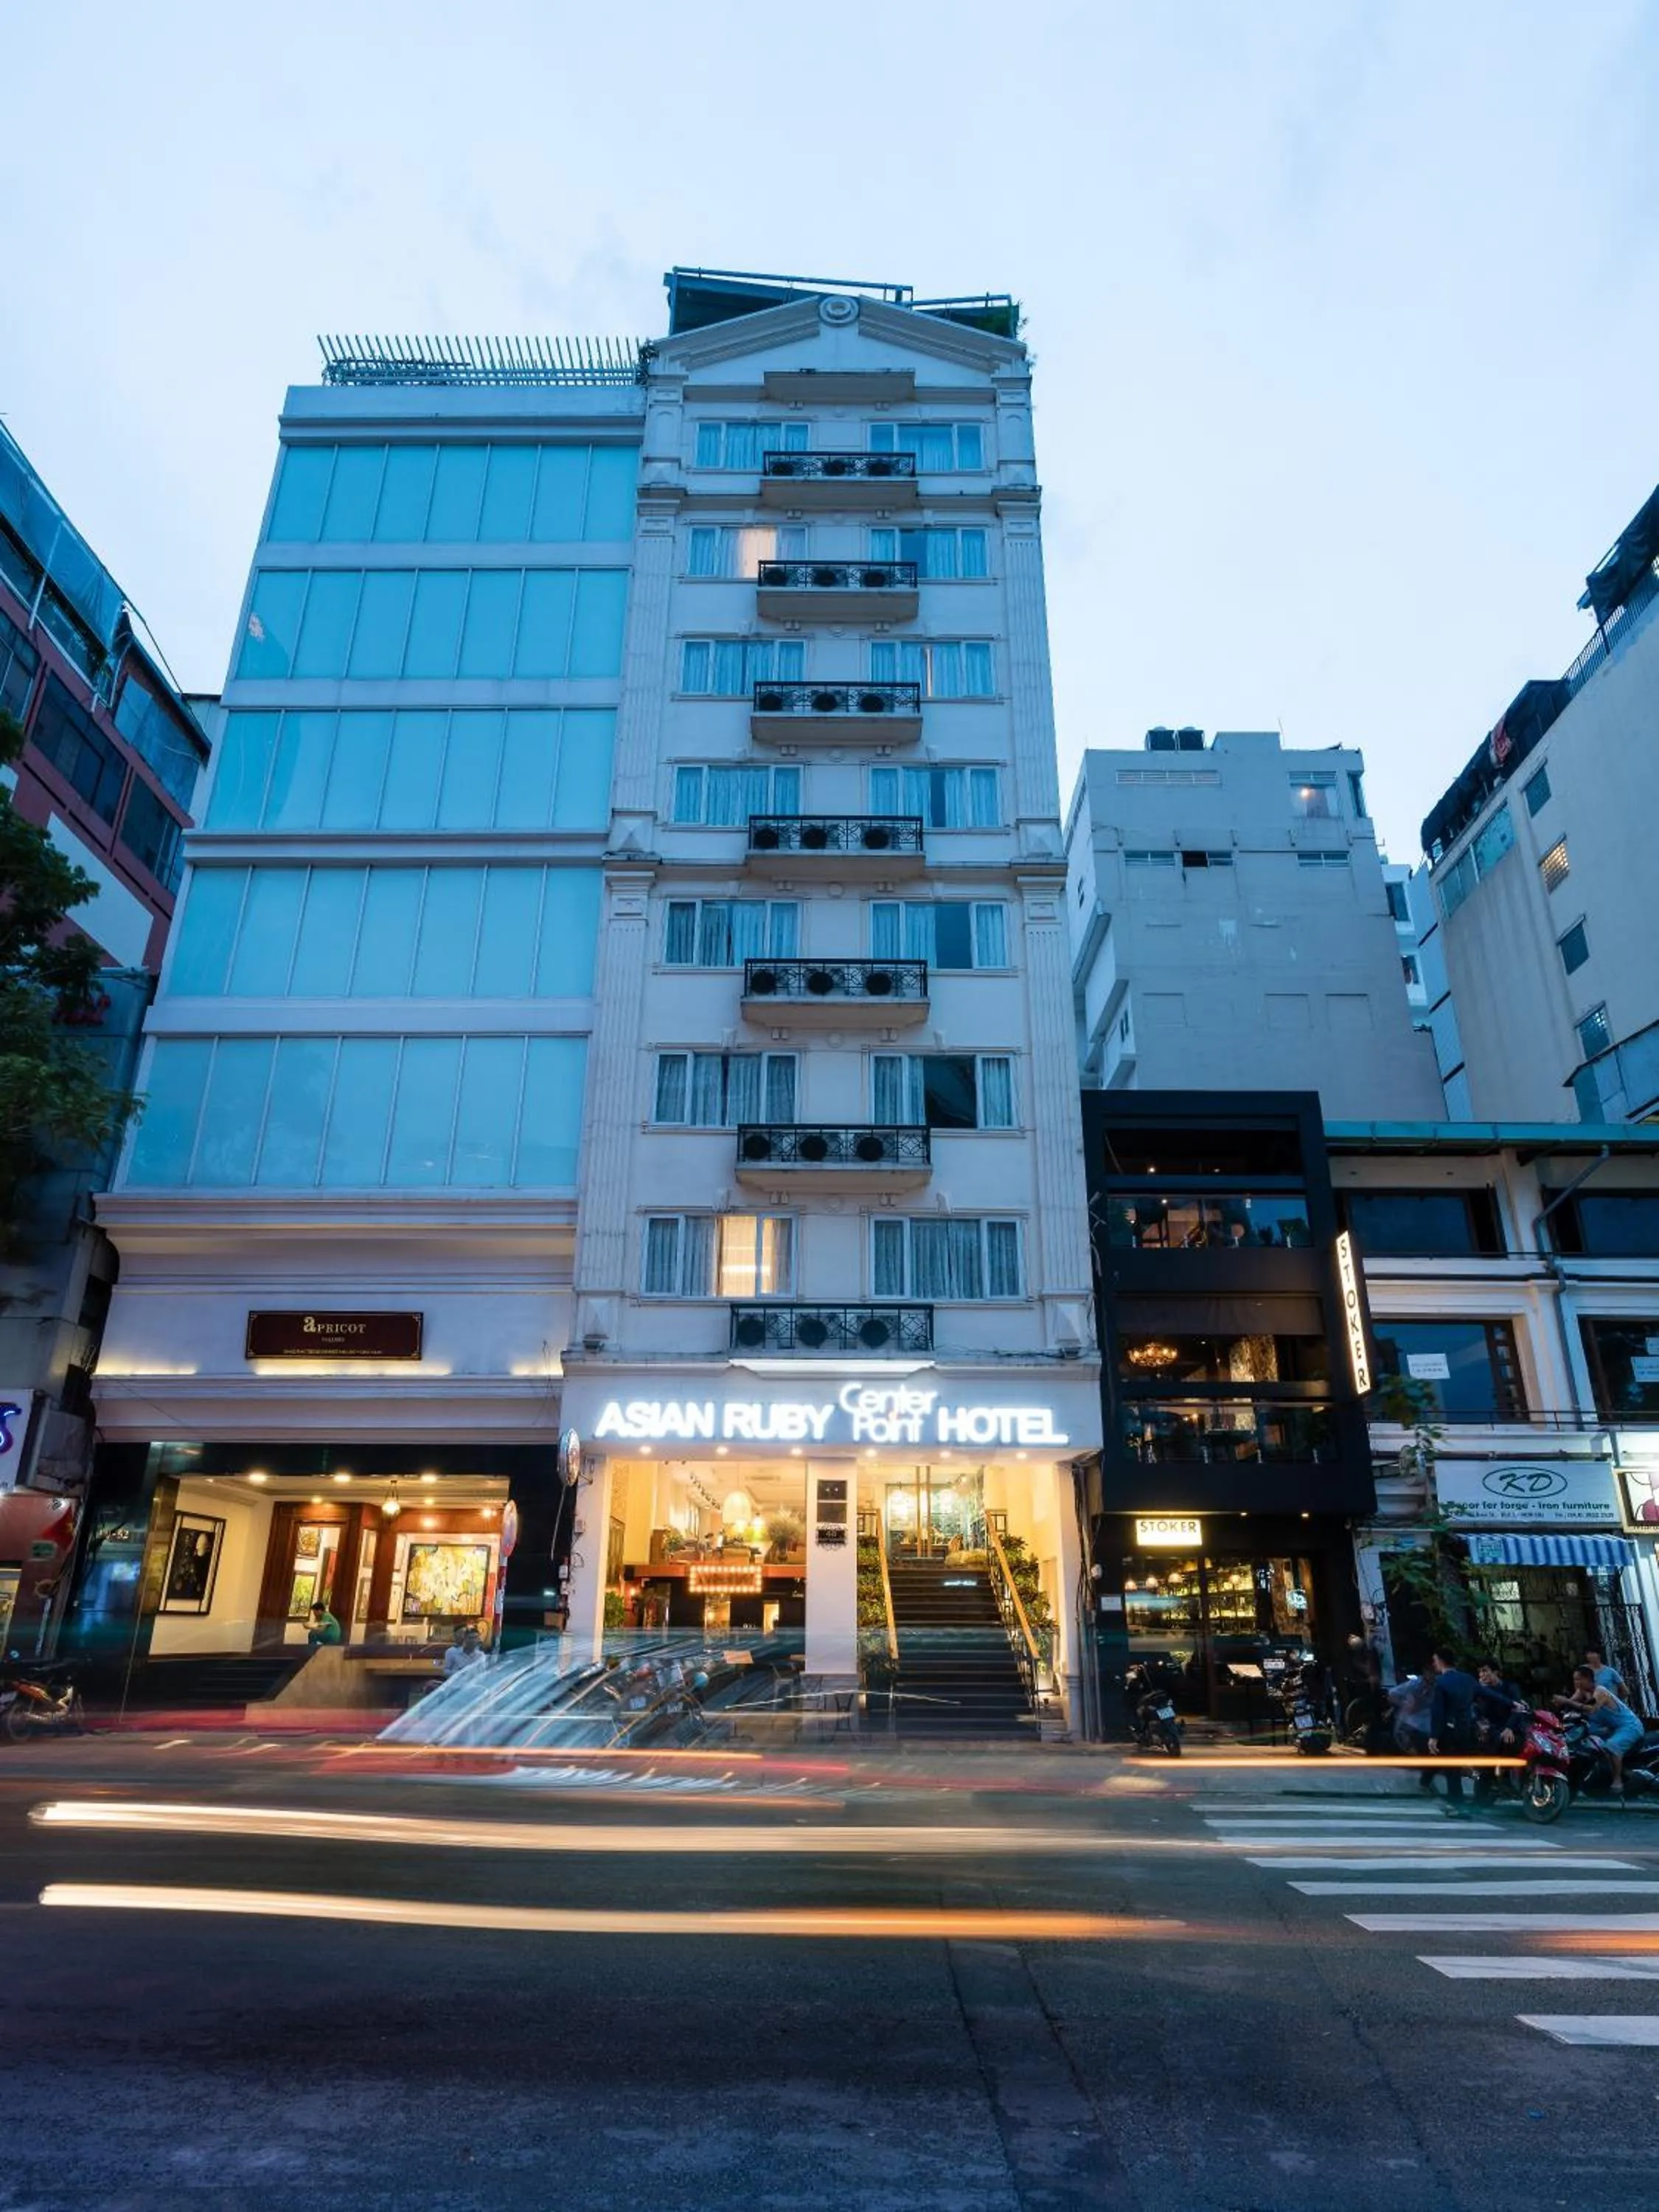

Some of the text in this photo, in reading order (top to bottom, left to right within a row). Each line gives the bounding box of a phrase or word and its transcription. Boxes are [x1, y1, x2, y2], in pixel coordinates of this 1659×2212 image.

[1340, 1238, 1367, 1388] STOKER
[839, 1383, 938, 1414] Center
[594, 1401, 1069, 1444] ASIAN RUBY HOTEL
[853, 1409, 923, 1442] Point
[1141, 1521, 1197, 1533] STOKER
